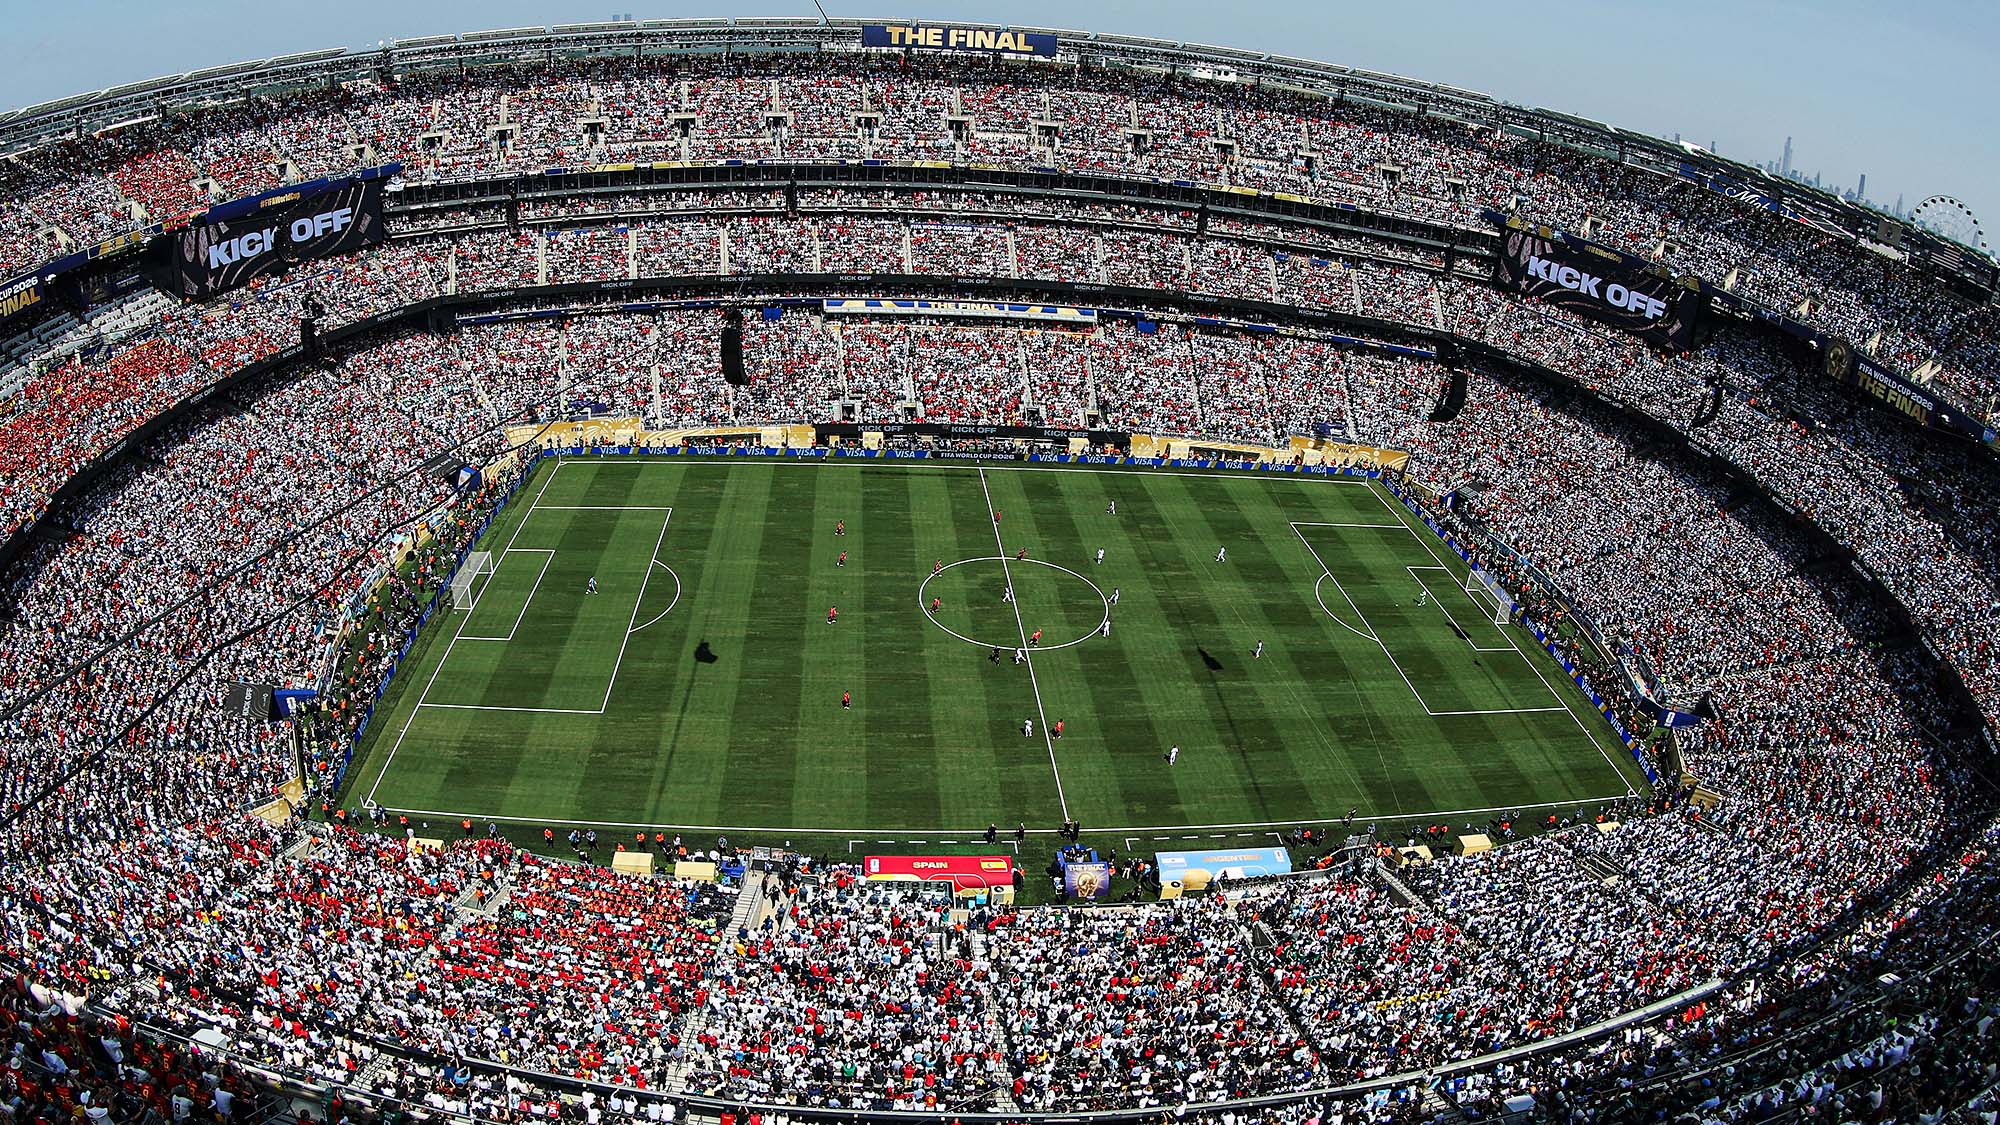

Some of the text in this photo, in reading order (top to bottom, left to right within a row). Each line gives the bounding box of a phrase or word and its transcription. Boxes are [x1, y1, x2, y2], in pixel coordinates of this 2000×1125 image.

[885, 26, 1034, 52] THE FINAL
[260, 192, 301, 209] #FIFAWorldCup
[291, 207, 352, 243] OFF
[13, 276, 39, 294] 2026
[1527, 255, 1667, 319] KICK OFF
[930, 302, 998, 311] THE FINAL
[190, 386, 216, 404] KICK OFF
[1859, 363, 1934, 411] FIFA WORLD CUP 2026
[1857, 370, 1930, 426] THE FINAL
[1044, 429, 1067, 437] KICK
[104, 440, 127, 461] KICK OFF
[795, 448, 815, 456] VISA
[894, 450, 915, 458] VISA
[1038, 454, 1058, 462] VISA
[1087, 455, 1106, 463] VISA
[1351, 468, 1368, 476] VISA
[1428, 520, 1439, 534] VISA
[1452, 540, 1463, 557] VISA
[1500, 590, 1512, 606] VISA
[422, 603, 433, 622] VISA
[1526, 617, 1538, 635] VISA
[401, 636, 413, 655] VISA
[1552, 646, 1566, 667] VISA
[379, 673, 390, 694] VISA
[1581, 678, 1595, 700] VISA
[242, 687, 254, 716] KICK OFF
[1610, 714, 1624, 737] VISA
[1638, 751, 1650, 776] VISA
[912, 861, 948, 869] SPAIN
[175, 1103, 181, 1114] 9
